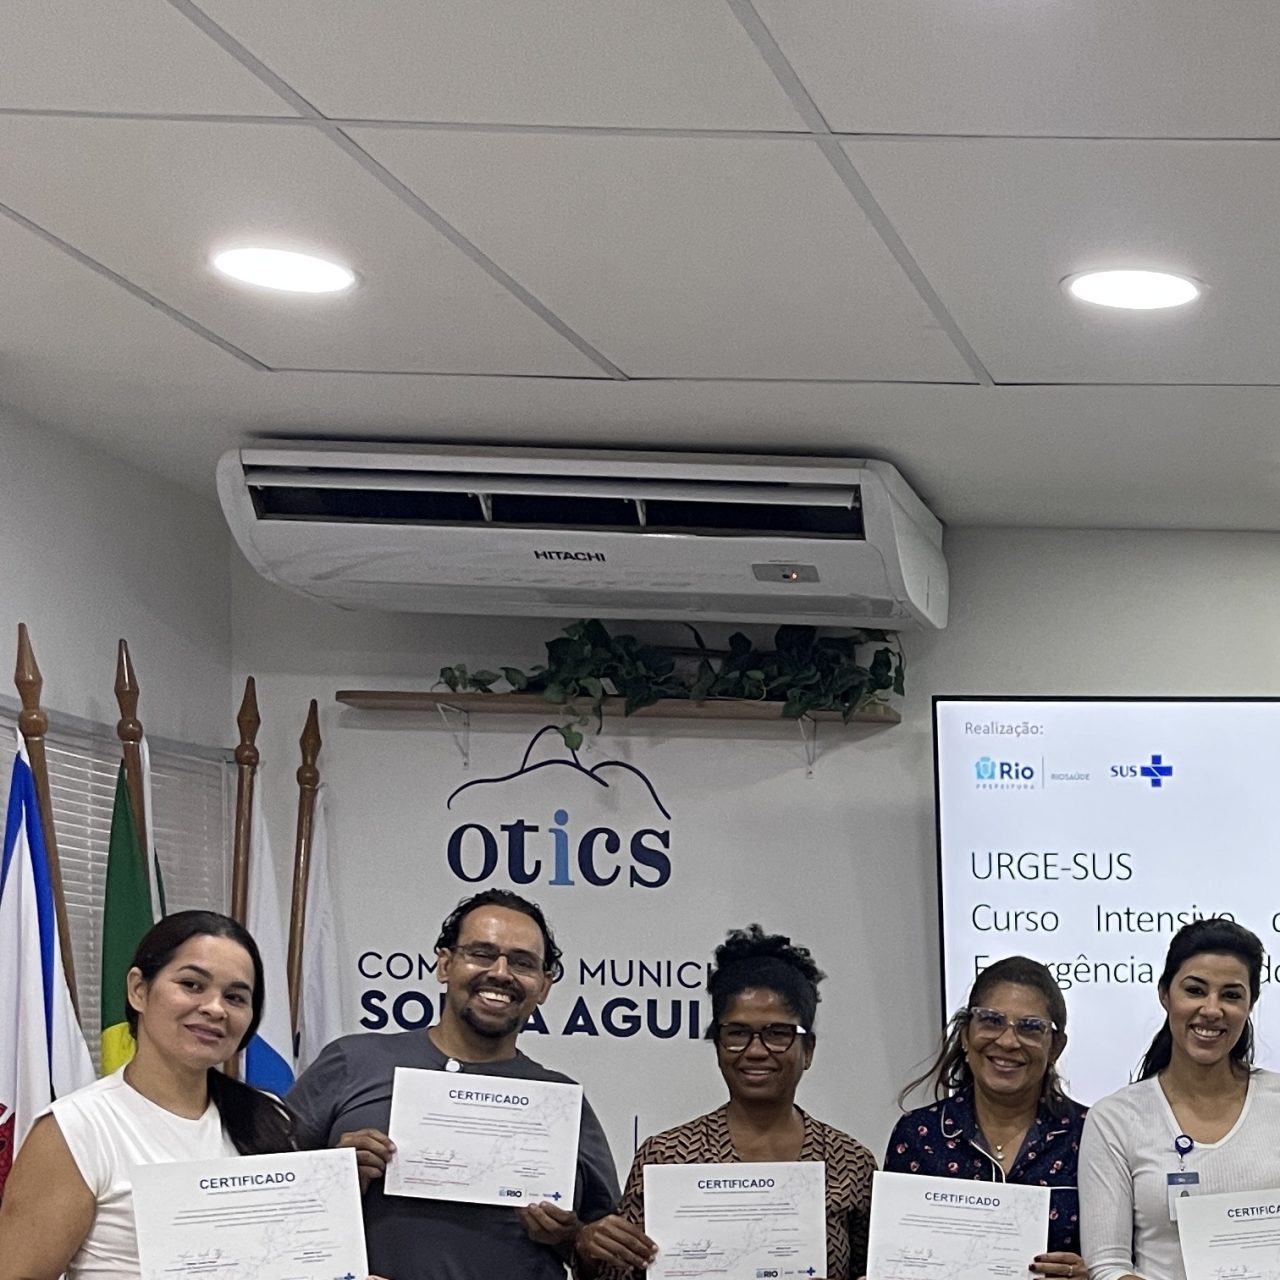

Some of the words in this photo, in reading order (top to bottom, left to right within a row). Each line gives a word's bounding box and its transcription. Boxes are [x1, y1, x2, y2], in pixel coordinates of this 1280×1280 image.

[534, 550, 606, 562] HITACHI
[965, 722, 1044, 738] Realização:
[1000, 762, 1034, 780] Rio
[1110, 765, 1138, 778] SUS
[447, 809, 672, 889] otics
[971, 852, 1133, 881] URGE-SUS
[972, 904, 1059, 932] Curso
[562, 996, 715, 1040] AGUI
[449, 1089, 530, 1106] CERTIFICADO
[199, 1172, 296, 1190] CERTIFICADO
[697, 1178, 775, 1189] CERTIFICADO
[924, 1191, 1001, 1207] CERTIFICADO
